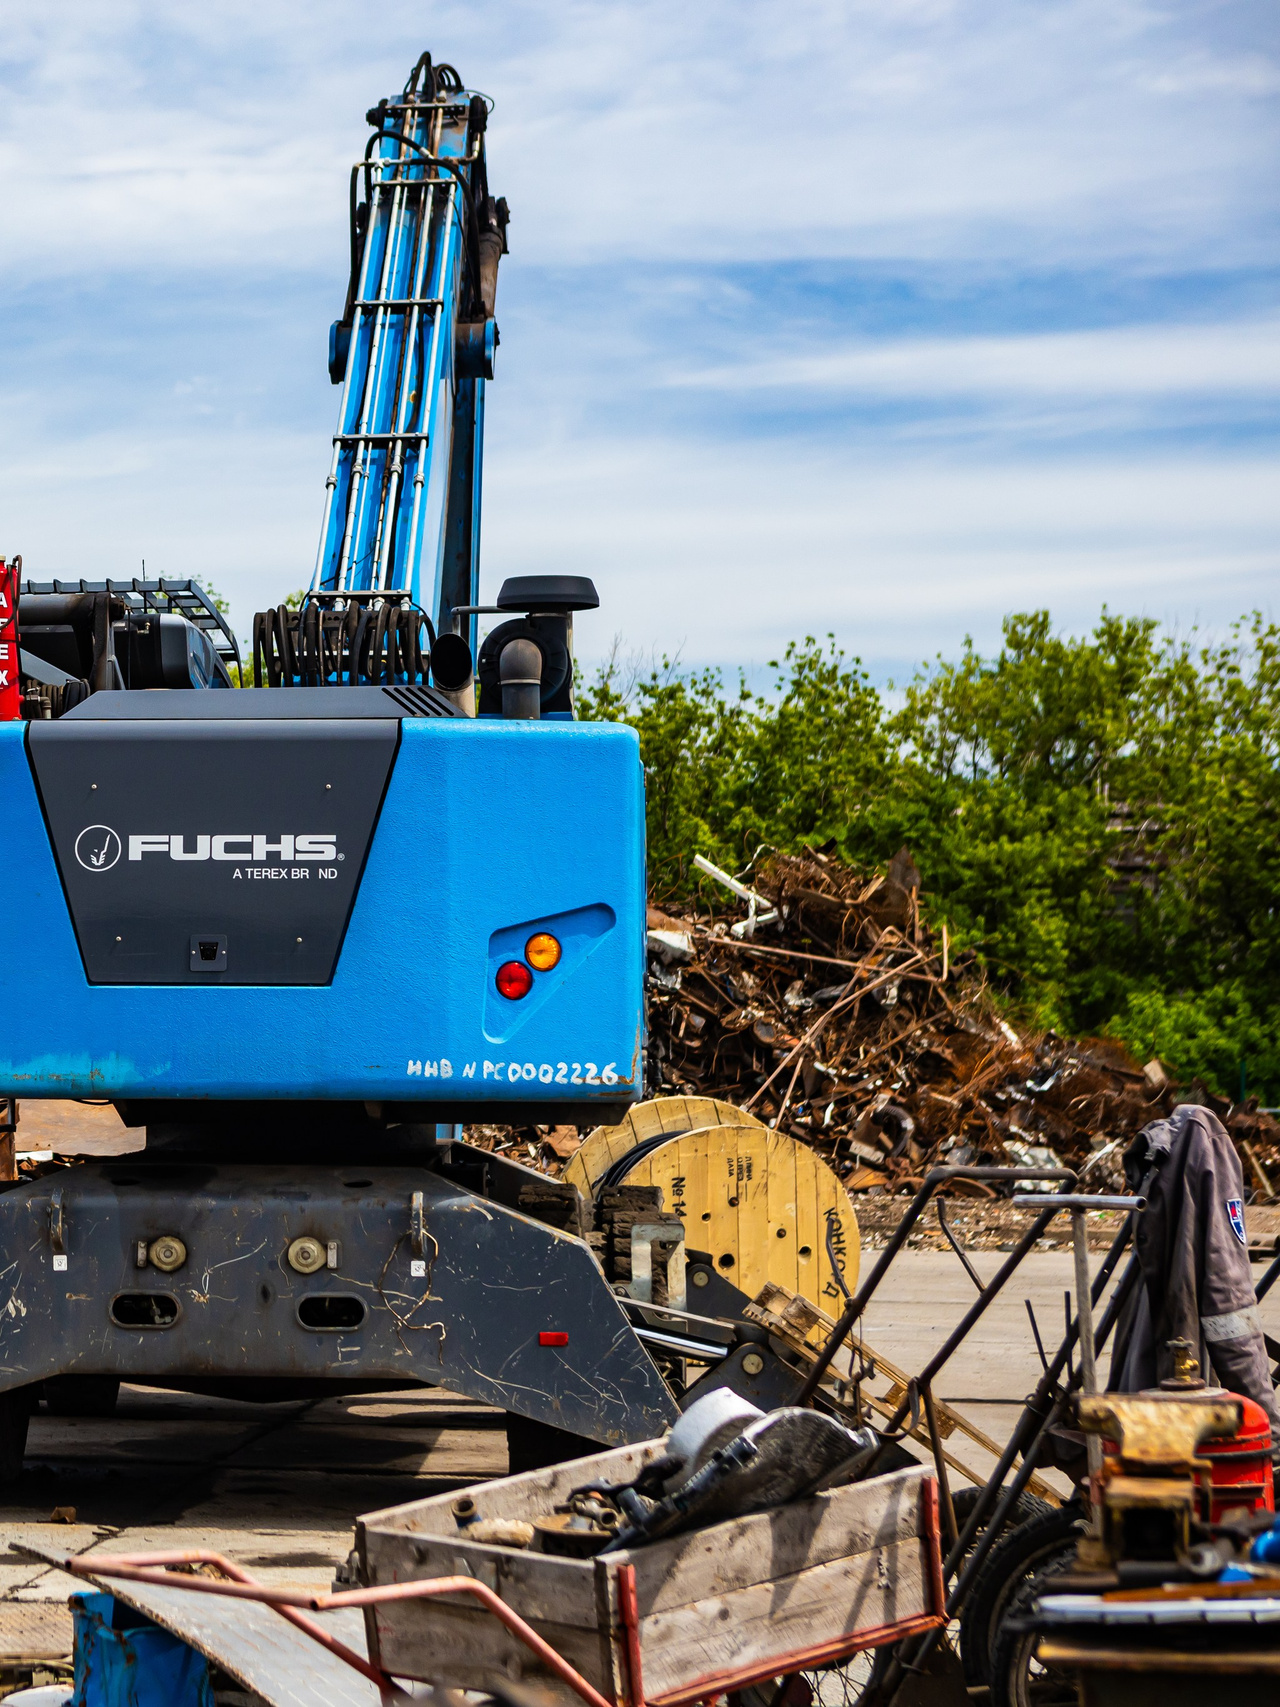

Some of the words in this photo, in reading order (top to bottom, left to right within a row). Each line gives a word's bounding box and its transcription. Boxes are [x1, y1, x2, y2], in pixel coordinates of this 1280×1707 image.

[128, 834, 337, 861] FUCHS
[232, 868, 243, 879] A
[245, 868, 288, 879] TEREX
[291, 868, 338, 879] BRND
[726, 1157, 734, 1177] ДАТА
[822, 1207, 847, 1299] КОНКОД
